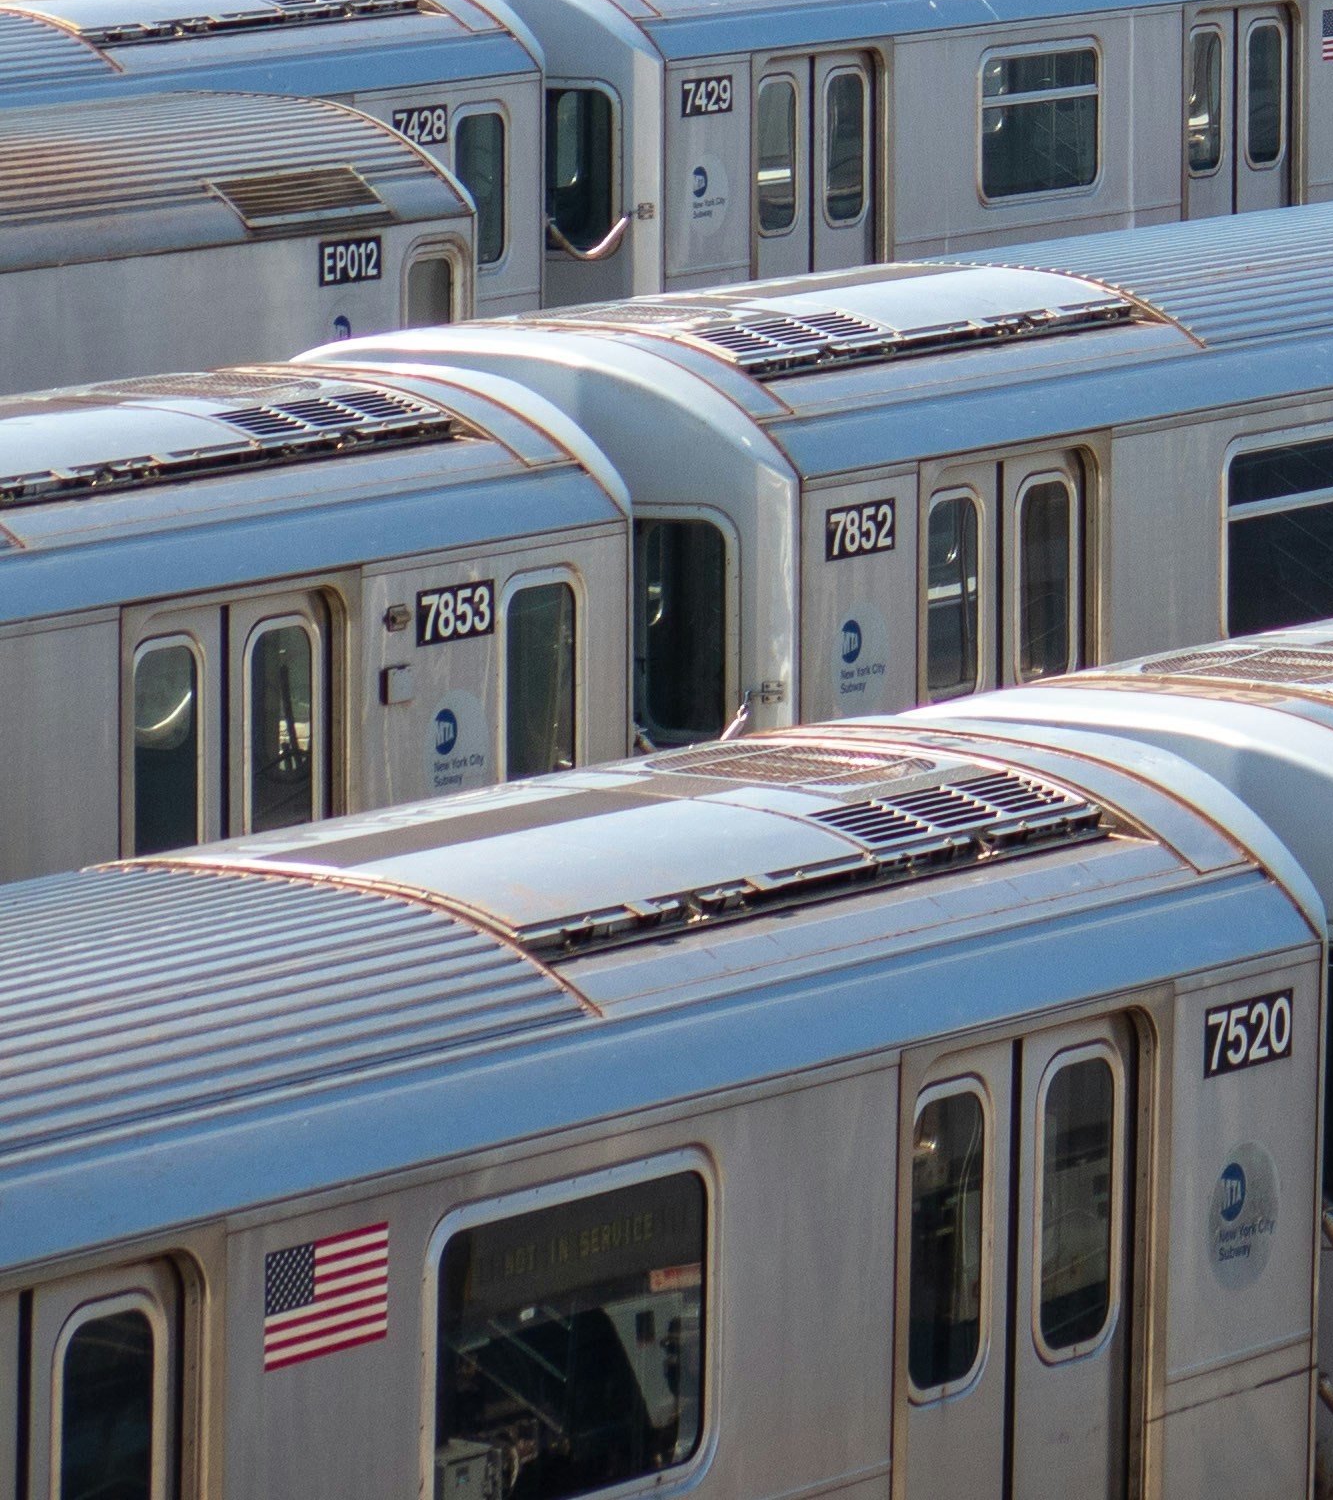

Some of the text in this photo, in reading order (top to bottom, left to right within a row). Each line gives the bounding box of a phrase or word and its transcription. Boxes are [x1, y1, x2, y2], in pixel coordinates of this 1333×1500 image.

[683, 78, 731, 115] 7429
[394, 108, 446, 143] 7428
[324, 242, 379, 282] EP012
[830, 504, 892, 557] 7852
[420, 585, 492, 641] 7853
[840, 664, 885, 679] New York City
[840, 681, 866, 694] Subway
[434, 755, 484, 773] New York City
[434, 774, 462, 789] Subway
[1207, 996, 1291, 1071] 7520
[551, 1236, 569, 1264] IN
[578, 1212, 654, 1257] SERVICE
[1219, 1219, 1276, 1245] New York City
[1219, 1245, 1251, 1263] Subway
